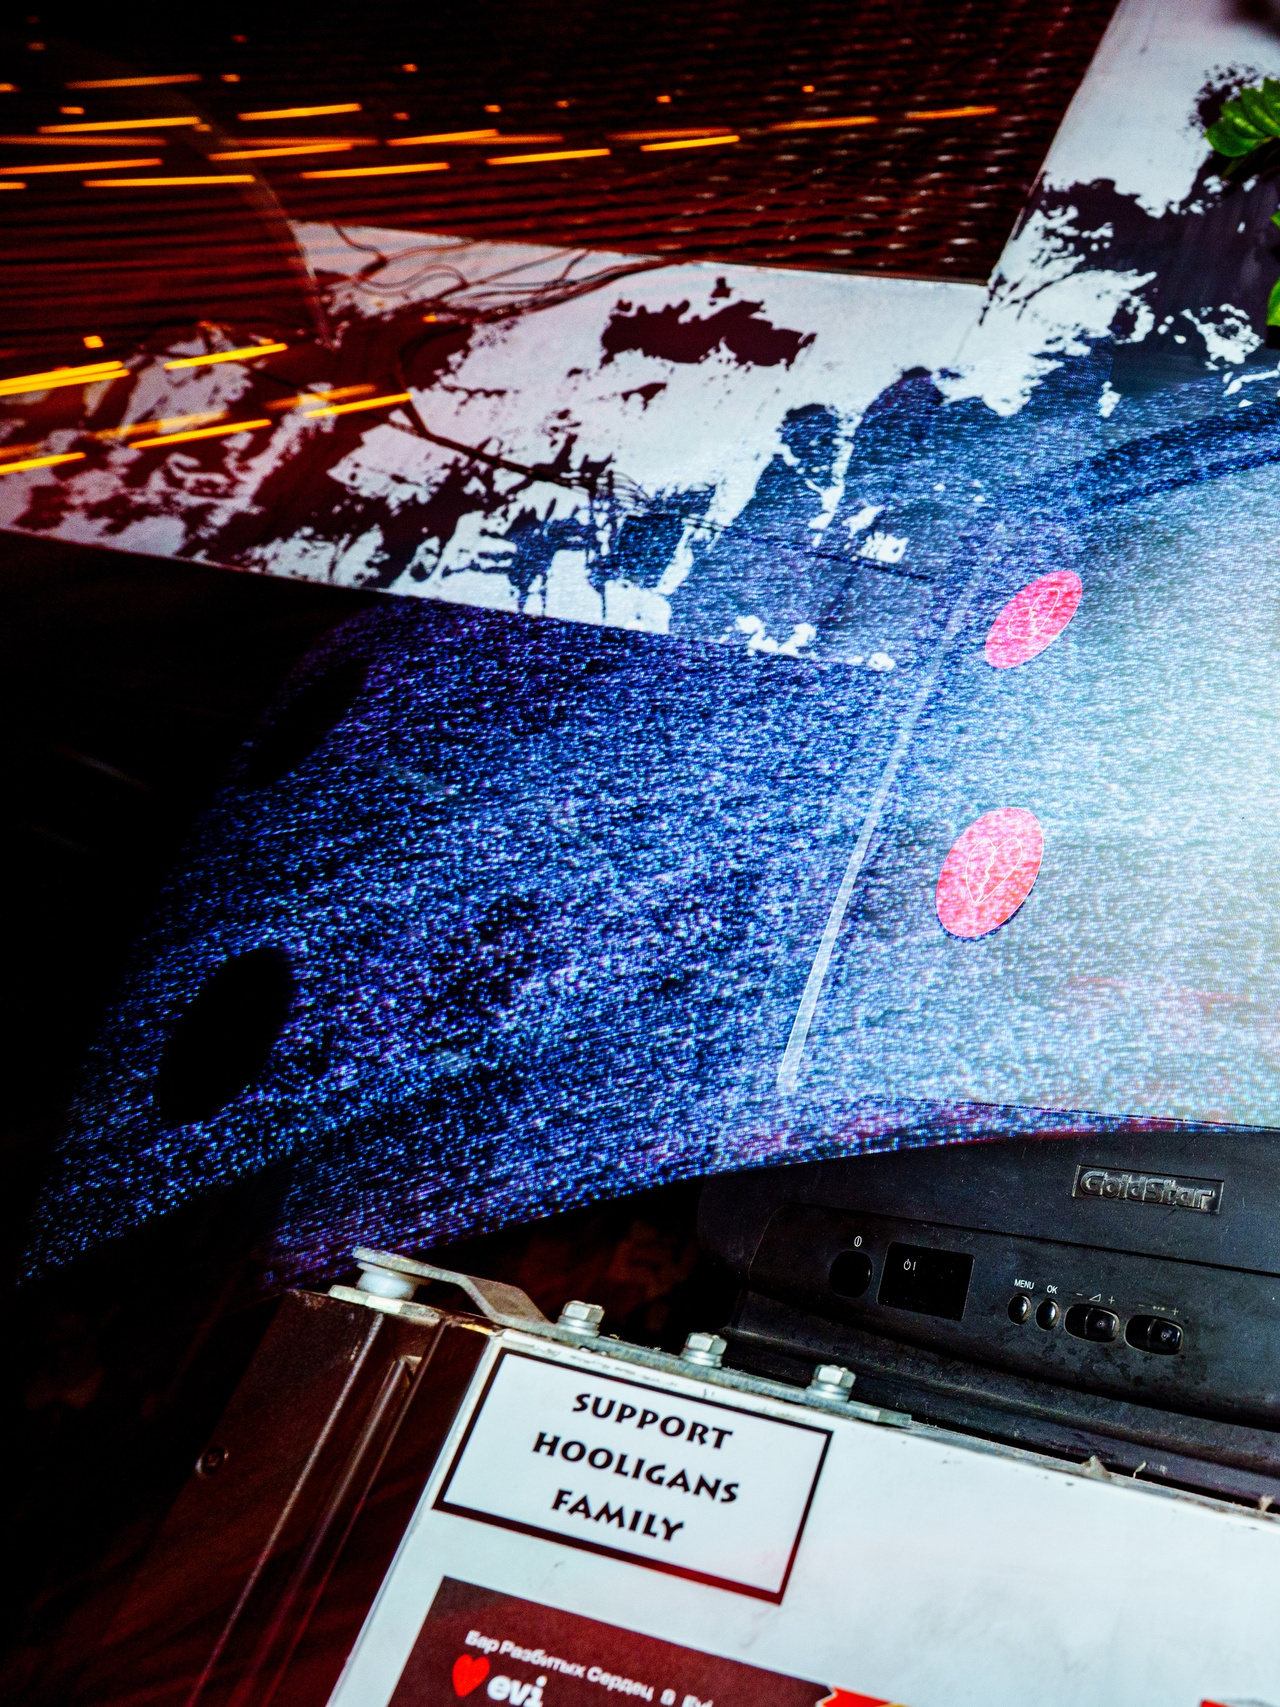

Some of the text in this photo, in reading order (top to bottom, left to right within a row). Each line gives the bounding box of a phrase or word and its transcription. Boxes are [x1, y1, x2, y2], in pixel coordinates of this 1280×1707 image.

[1080, 1170, 1216, 1210] GoldStar
[1013, 1278, 1035, 1290] MENU
[1046, 1284, 1058, 1295] OK
[572, 1393, 734, 1450] SUPPORT
[533, 1431, 740, 1503] HOOLIGANS
[551, 1488, 684, 1542] FAMILY
[464, 1630, 500, 1654] Бар
